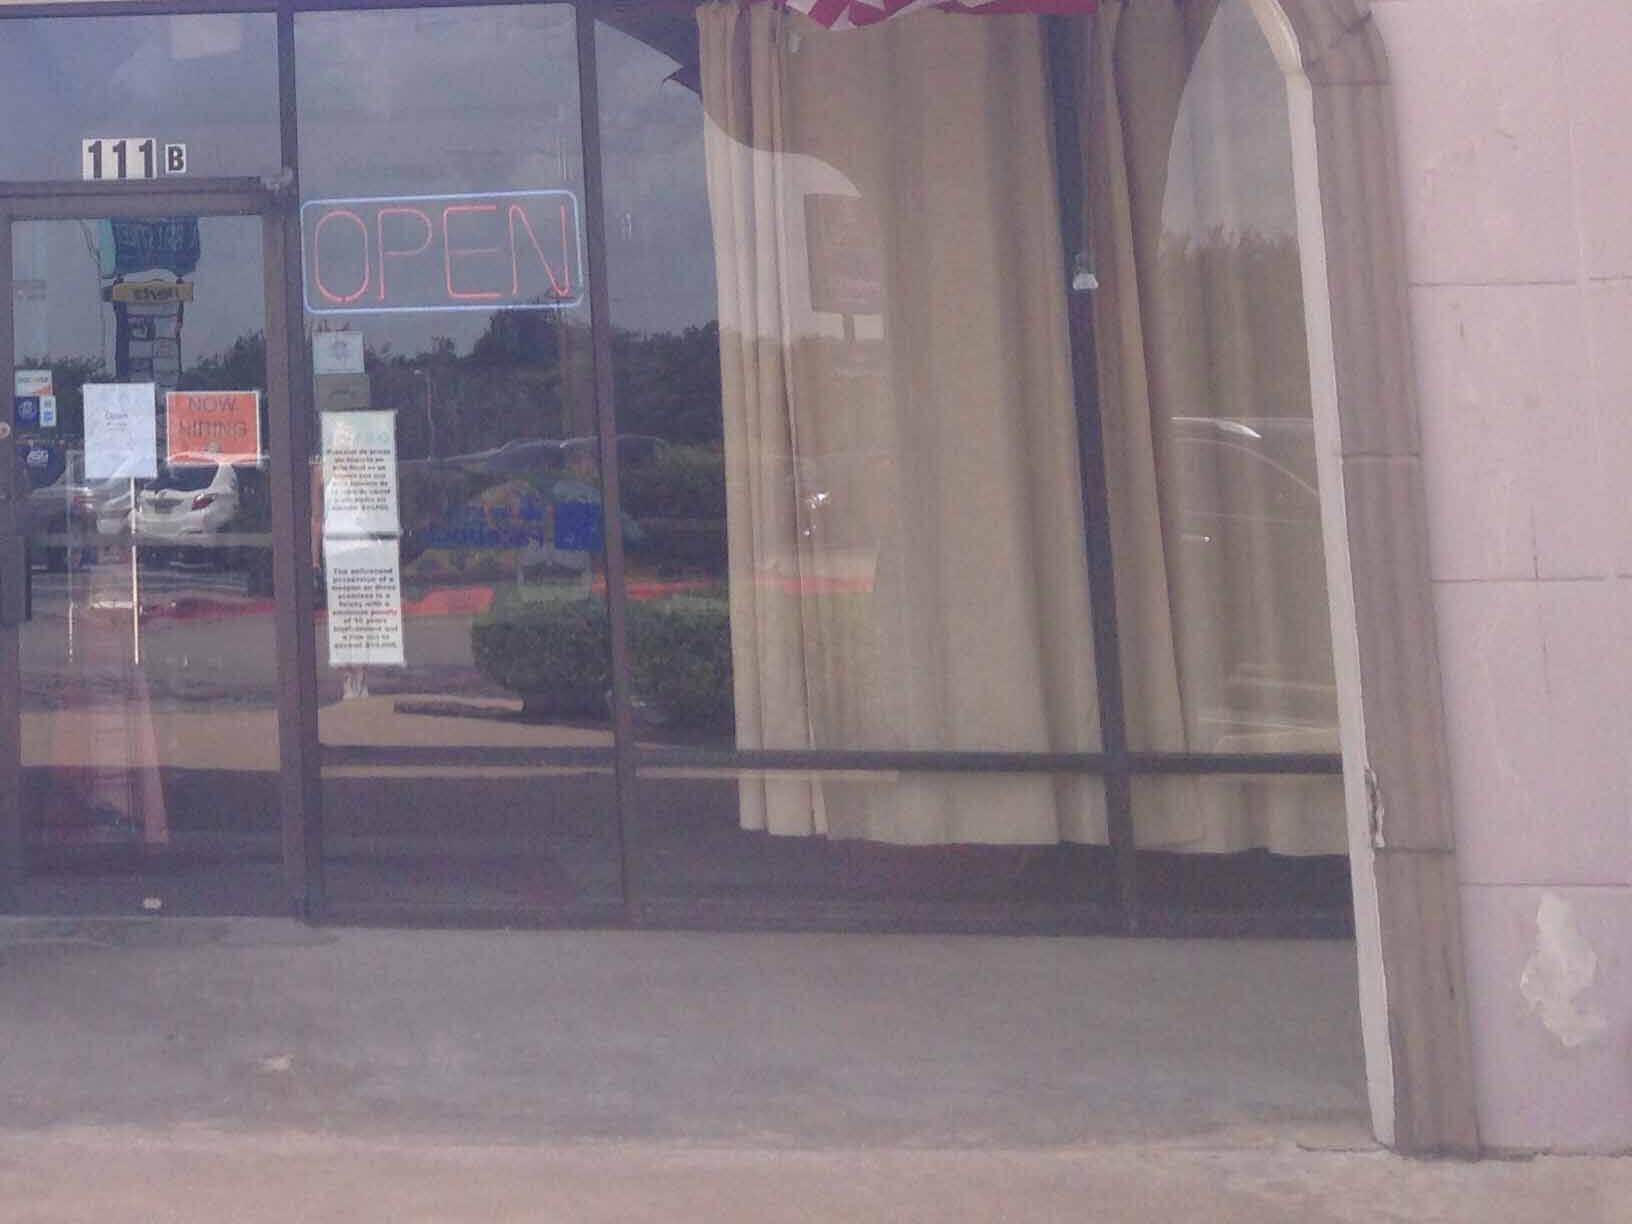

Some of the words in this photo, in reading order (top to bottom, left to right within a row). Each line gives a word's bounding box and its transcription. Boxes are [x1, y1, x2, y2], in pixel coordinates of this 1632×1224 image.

[87, 140, 153, 178] 111
[168, 146, 184, 171] B
[314, 204, 569, 301] OPEN
[189, 397, 237, 413] NOW
